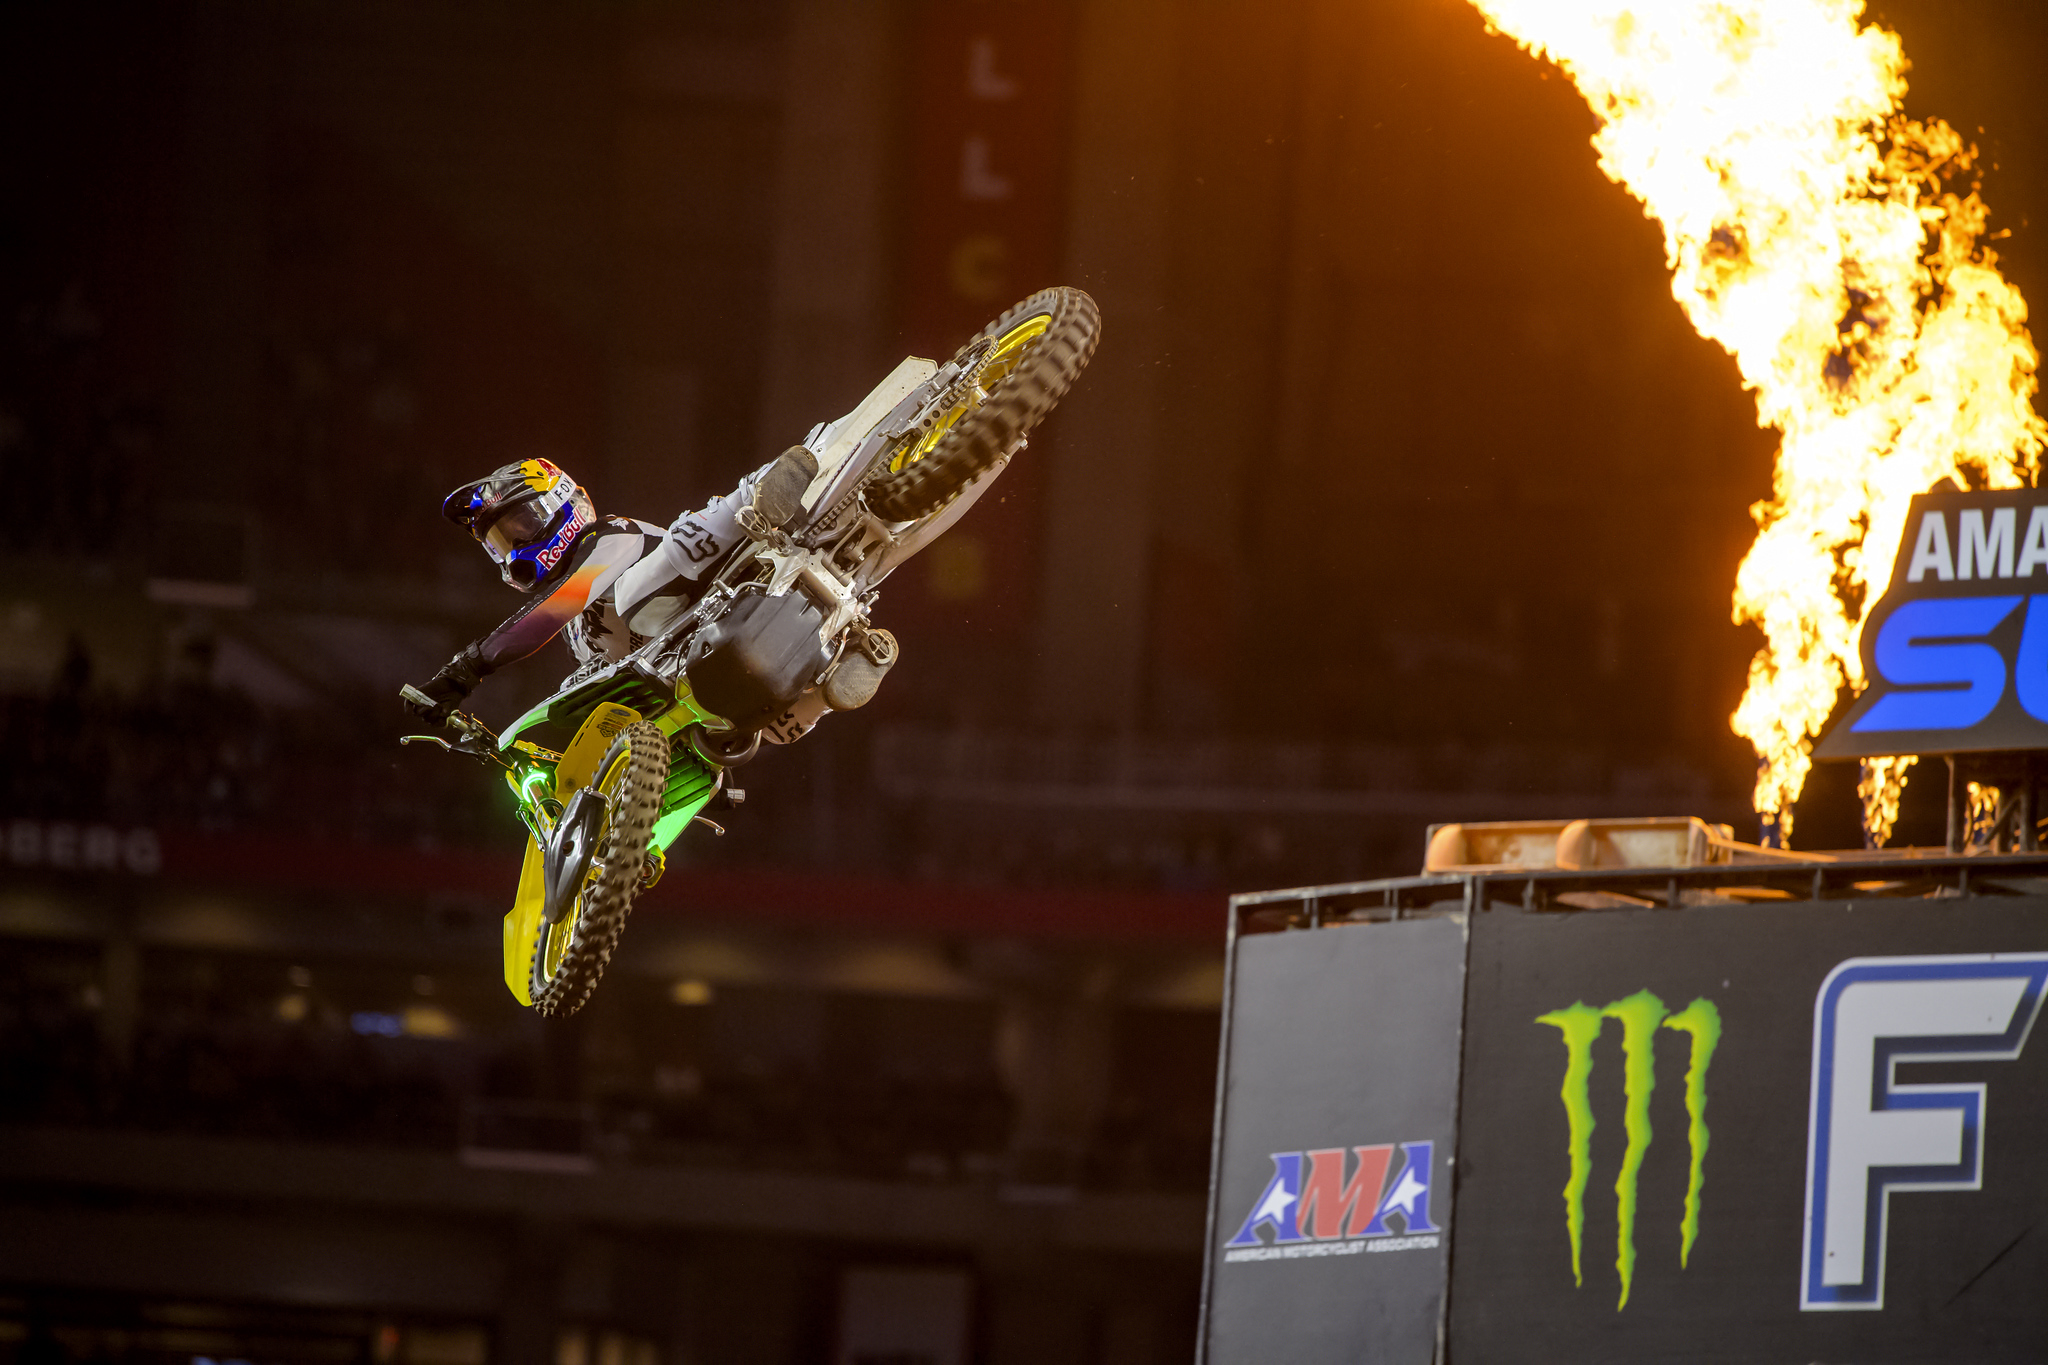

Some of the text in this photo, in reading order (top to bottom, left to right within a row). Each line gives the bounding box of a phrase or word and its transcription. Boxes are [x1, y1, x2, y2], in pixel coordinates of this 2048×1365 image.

[554, 477, 574, 501] FOX
[1907, 506, 2048, 582] AMA
[1850, 593, 2048, 732] S
[0, 820, 162, 875] BERG
[1224, 1140, 1441, 1248] AMA
[1224, 1247, 1281, 1263] AMERICAN
[1365, 1236, 1440, 1253] ASSOCIATION
